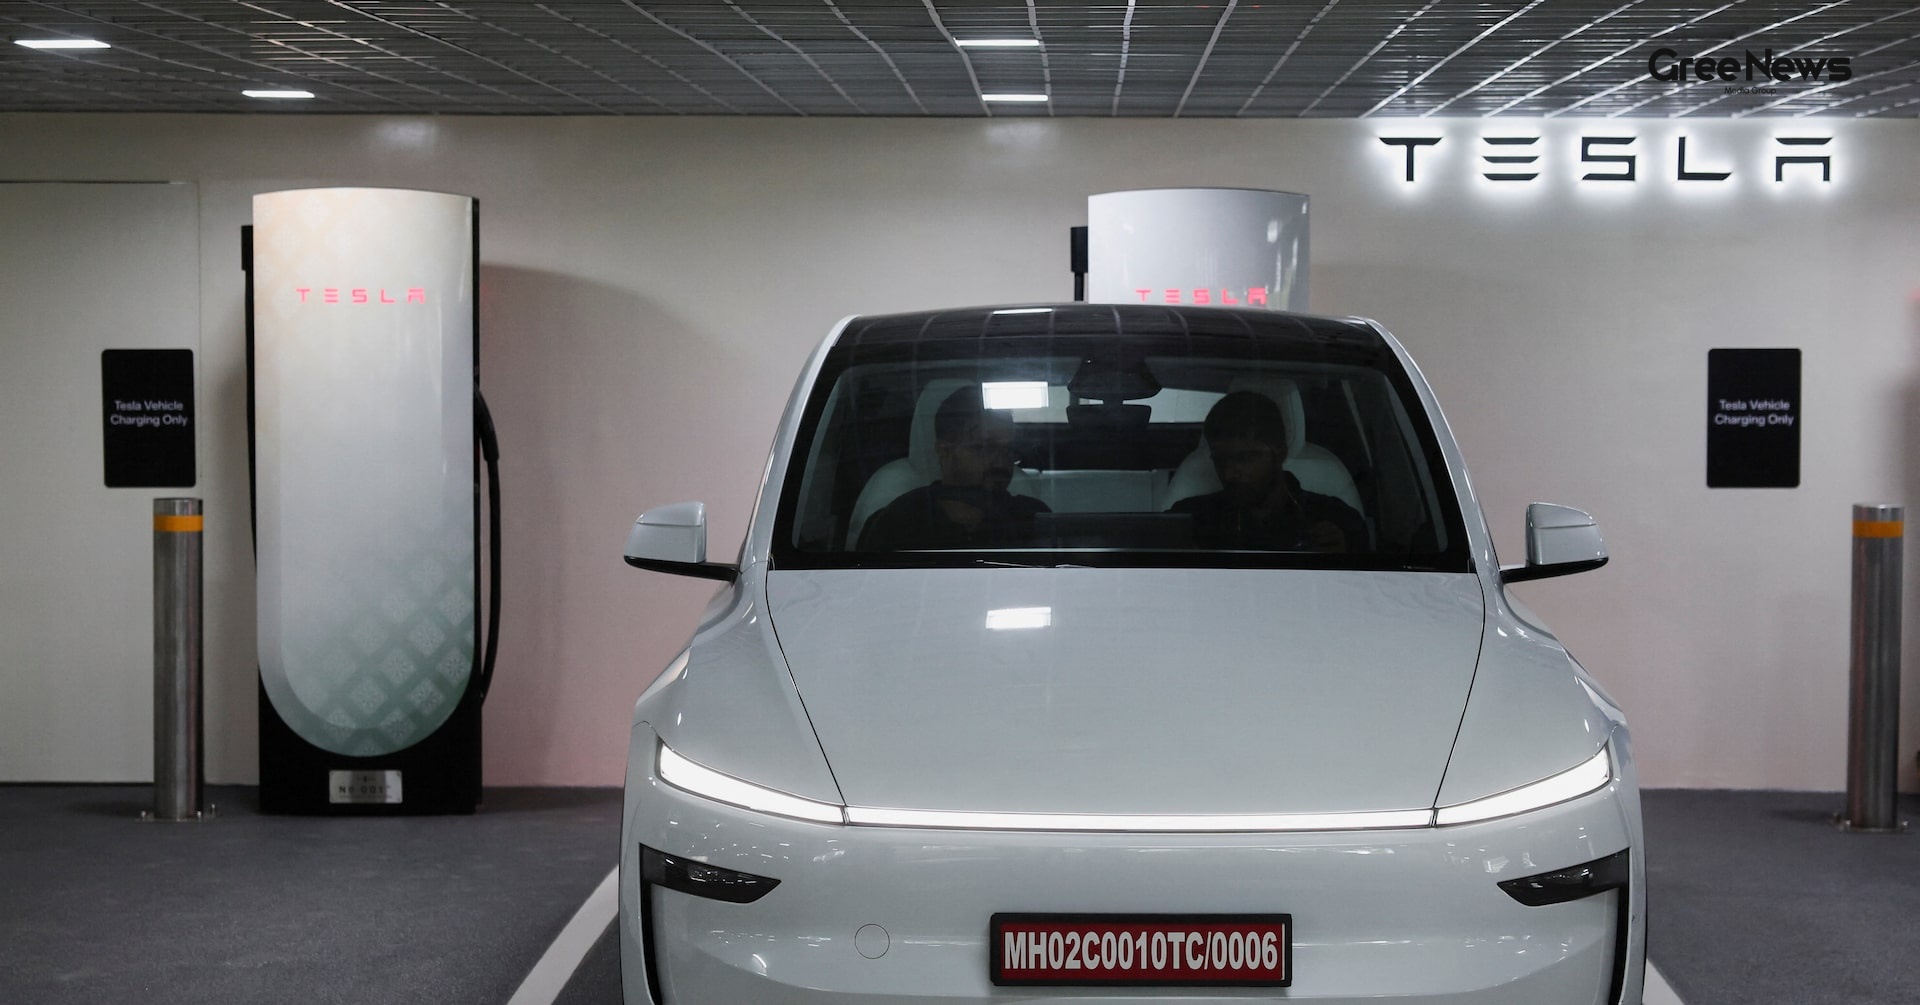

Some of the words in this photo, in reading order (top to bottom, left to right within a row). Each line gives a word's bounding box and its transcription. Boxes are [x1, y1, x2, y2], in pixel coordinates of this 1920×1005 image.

[1379, 136, 1833, 182] TESLA
[296, 288, 425, 304] TESLA
[1136, 287, 1267, 305] TESLA
[114, 400, 142, 411] Tesla
[144, 400, 184, 411] Vehicle
[1719, 399, 1747, 410] Tesla
[1750, 399, 1791, 410] Vehicle
[110, 414, 160, 427] Charging
[162, 414, 188, 427] Only
[1714, 413, 1766, 427] Charging
[1767, 413, 1795, 427] Only
[1004, 931, 1278, 970] MH02C0010TC/0006
